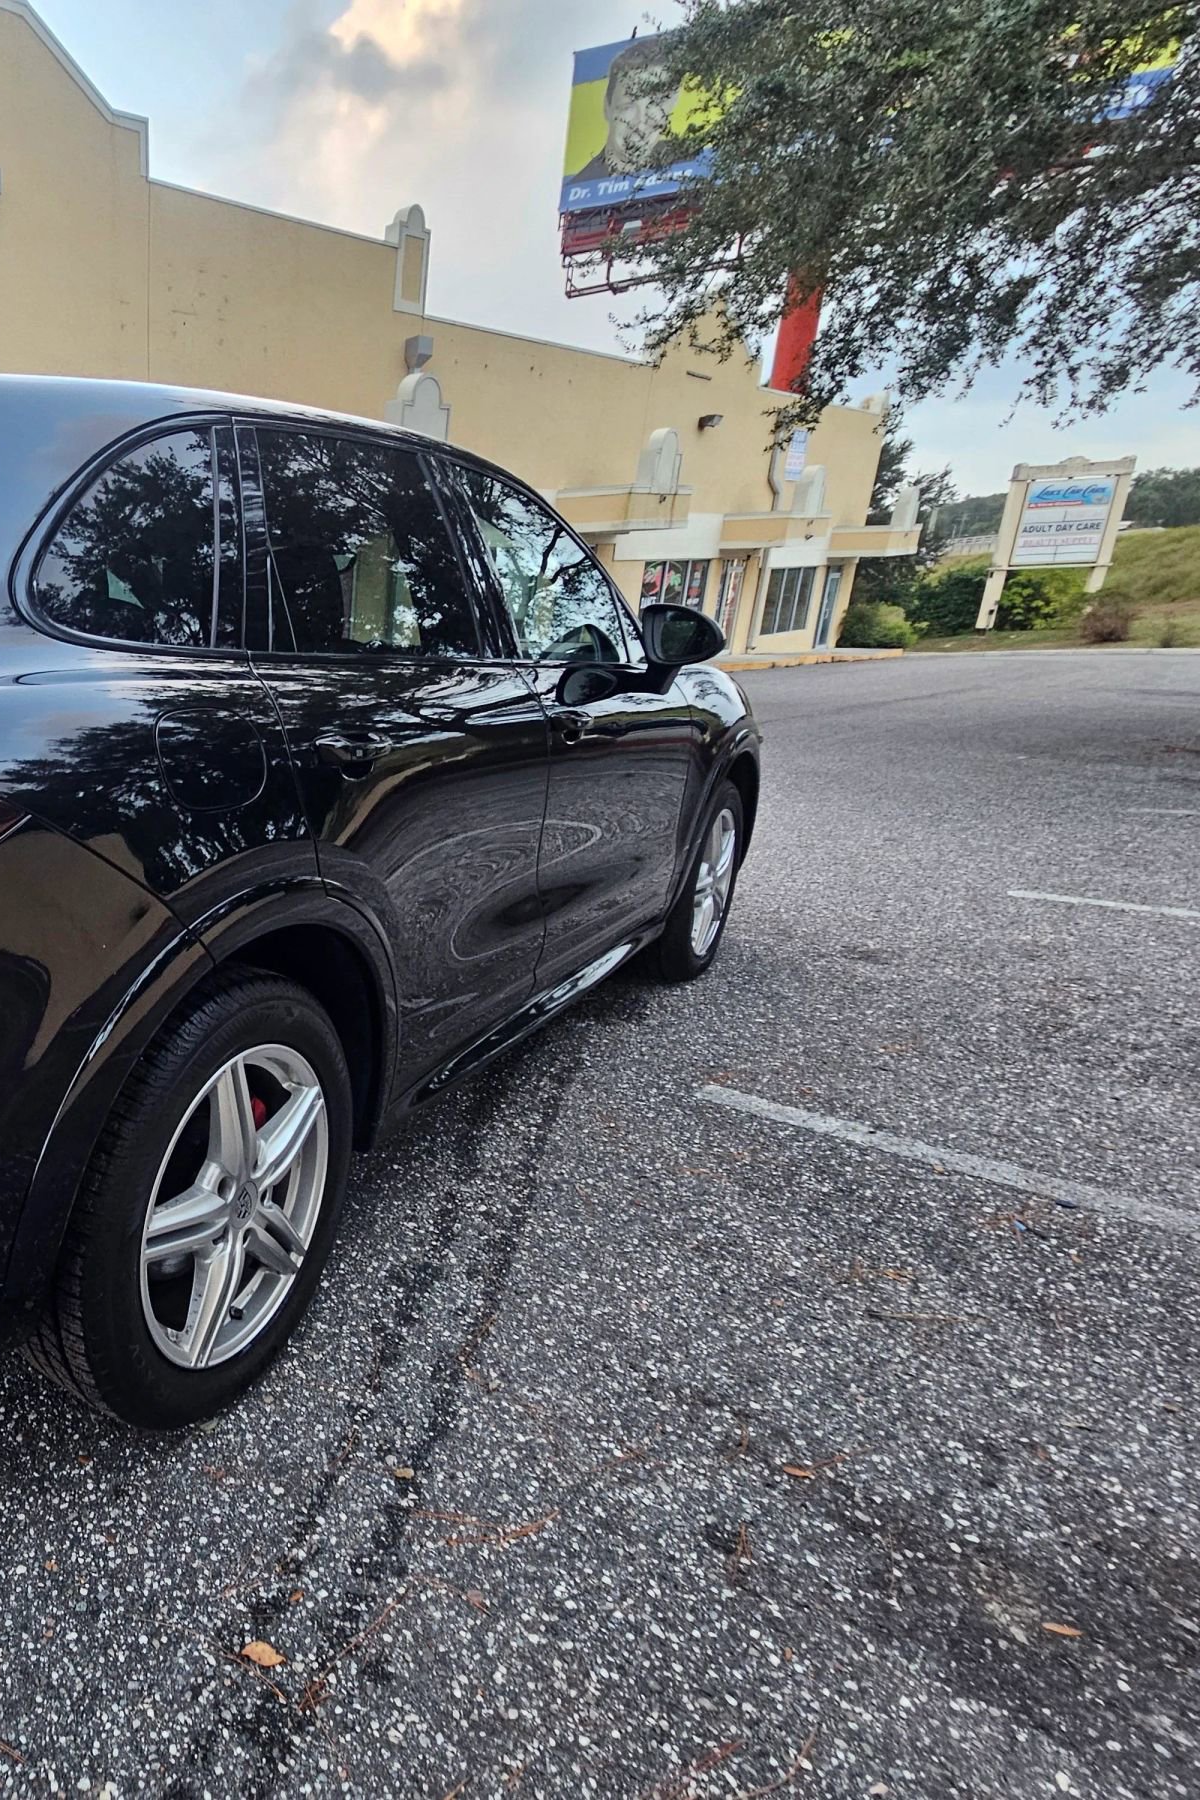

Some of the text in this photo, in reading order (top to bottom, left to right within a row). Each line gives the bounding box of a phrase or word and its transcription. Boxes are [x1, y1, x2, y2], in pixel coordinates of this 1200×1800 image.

[568, 168, 693, 201] Dr. Tim Ads
[1022, 521, 1103, 533] ADULT DAY CARE
